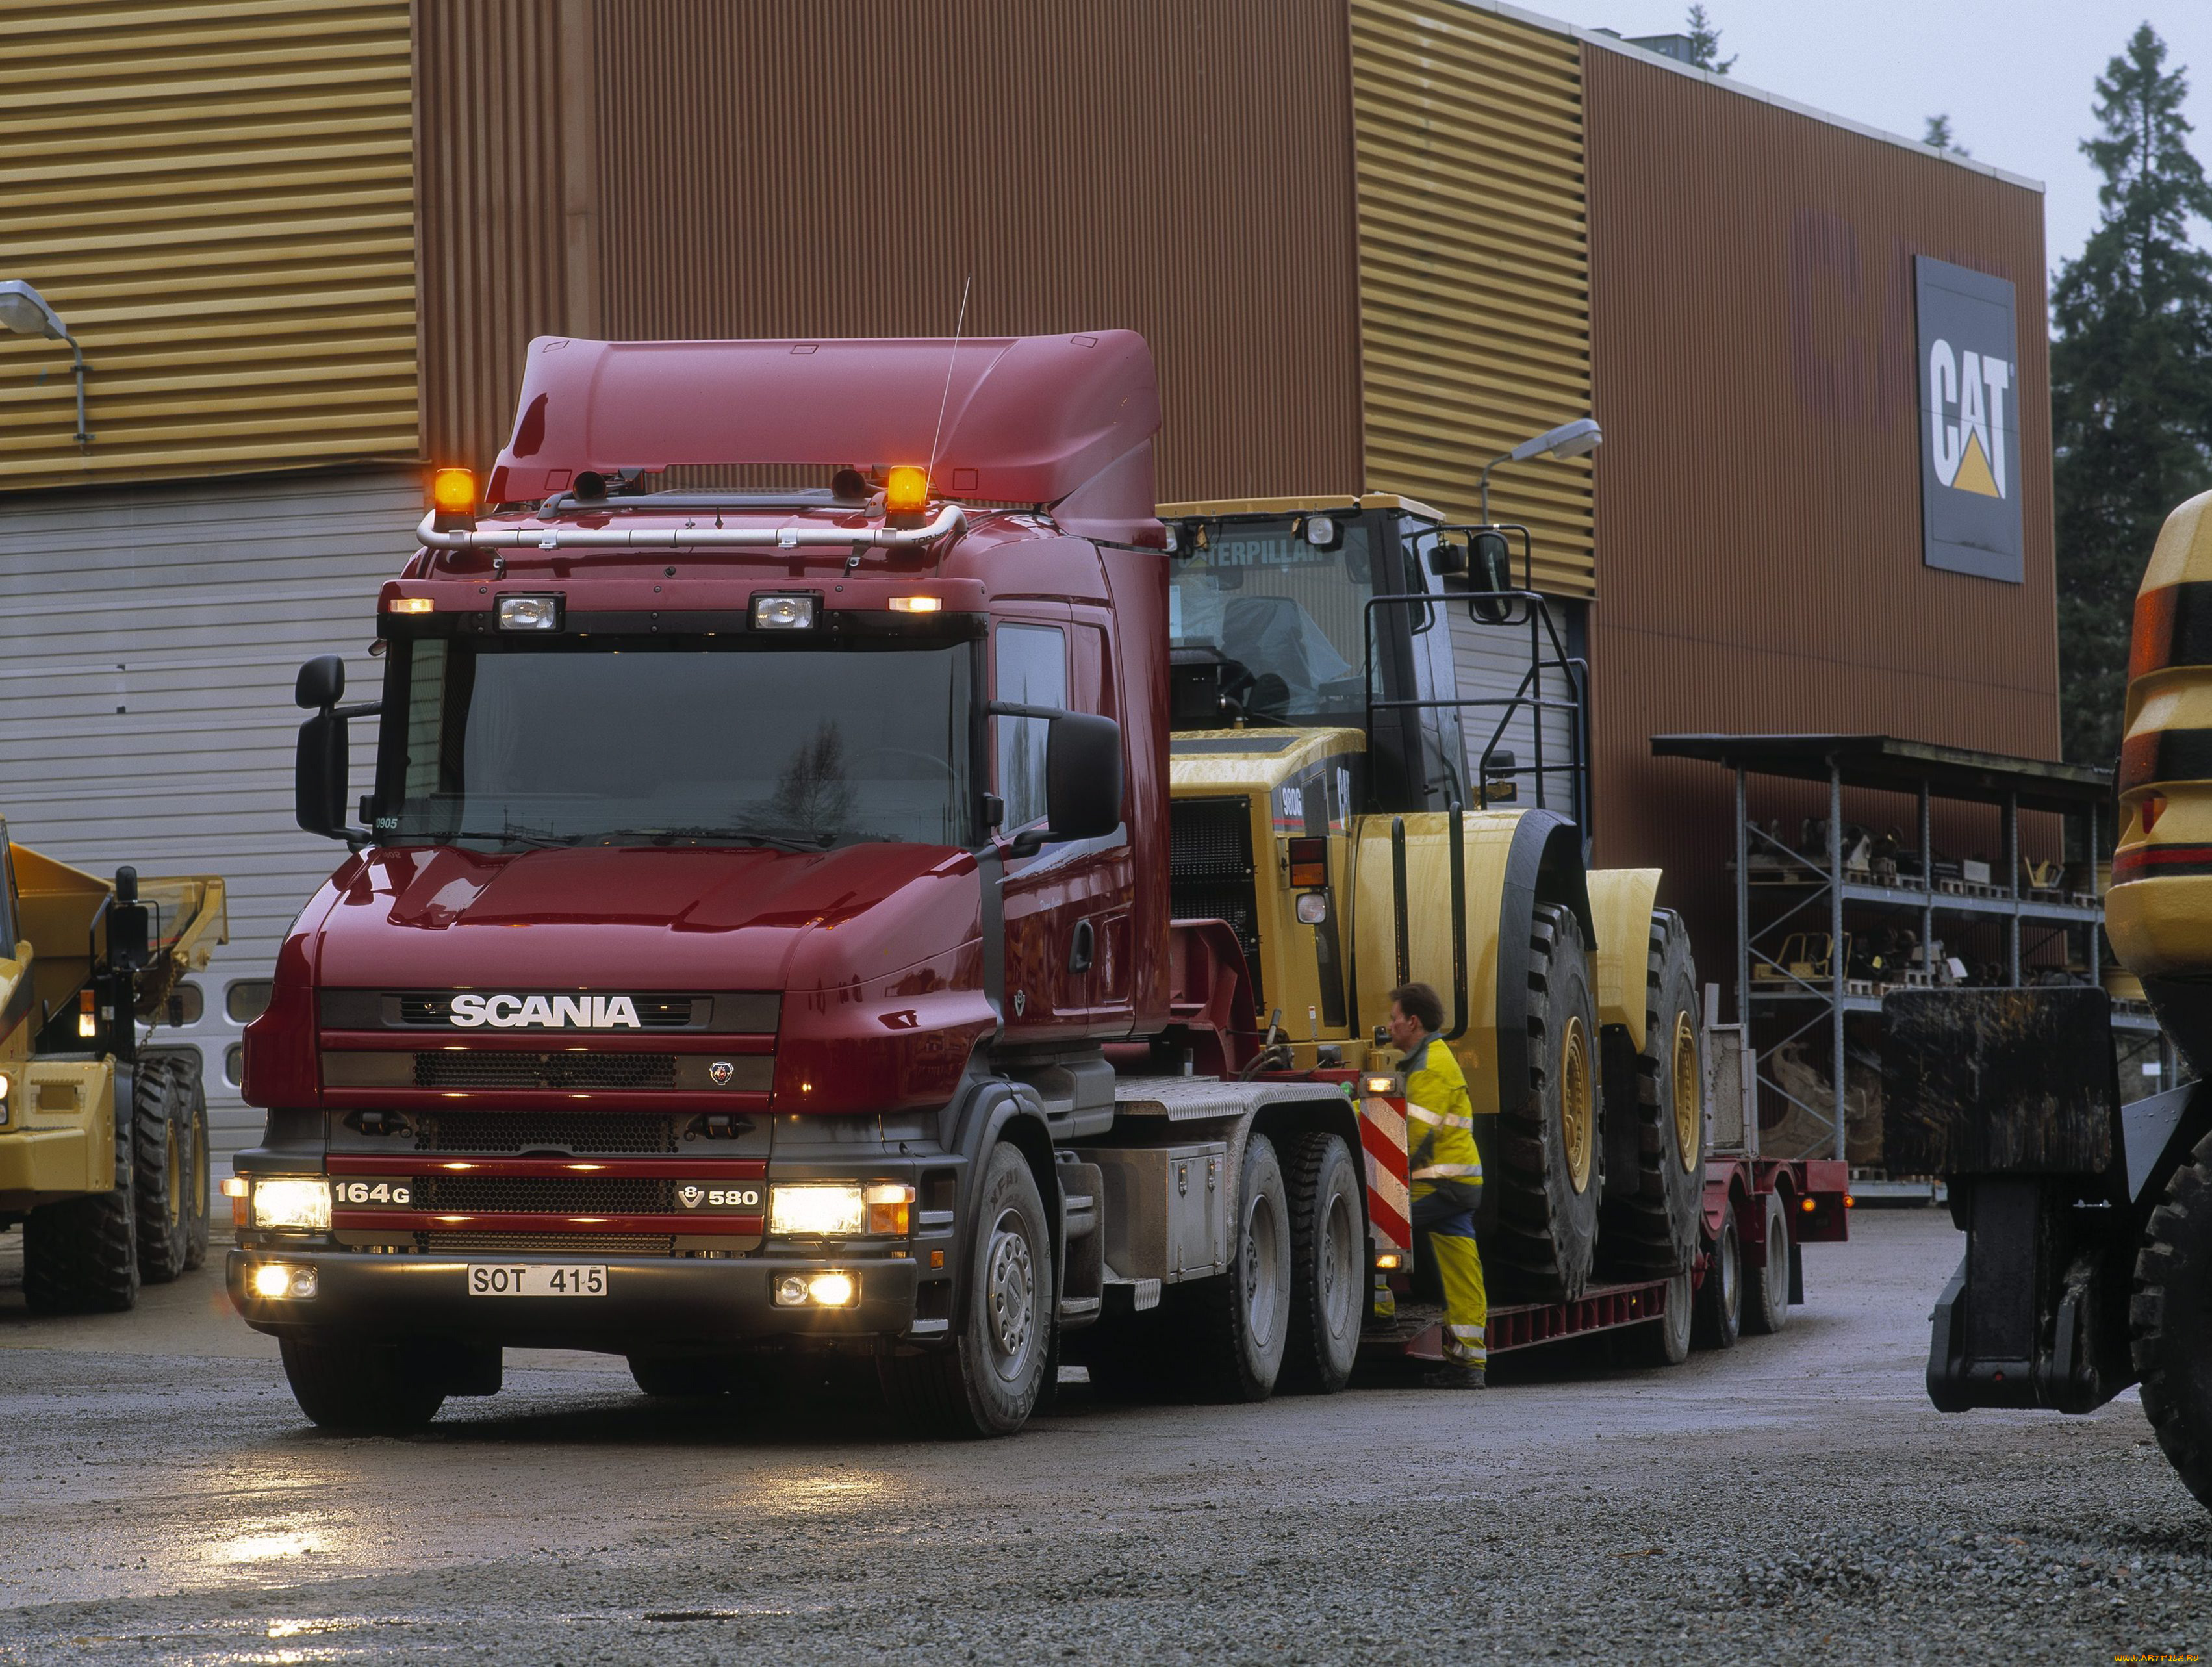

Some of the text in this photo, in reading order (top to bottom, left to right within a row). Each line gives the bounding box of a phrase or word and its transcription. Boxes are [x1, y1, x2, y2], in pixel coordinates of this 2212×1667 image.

[1930, 339, 2009, 499] CAT
[1282, 787, 1303, 816] 980G
[1336, 767, 1351, 830] CAT
[450, 995, 641, 1028] SCANIA
[335, 1182, 409, 1203] 164G
[709, 1191, 758, 1205] 580
[474, 1268, 602, 1293] SOT 415
